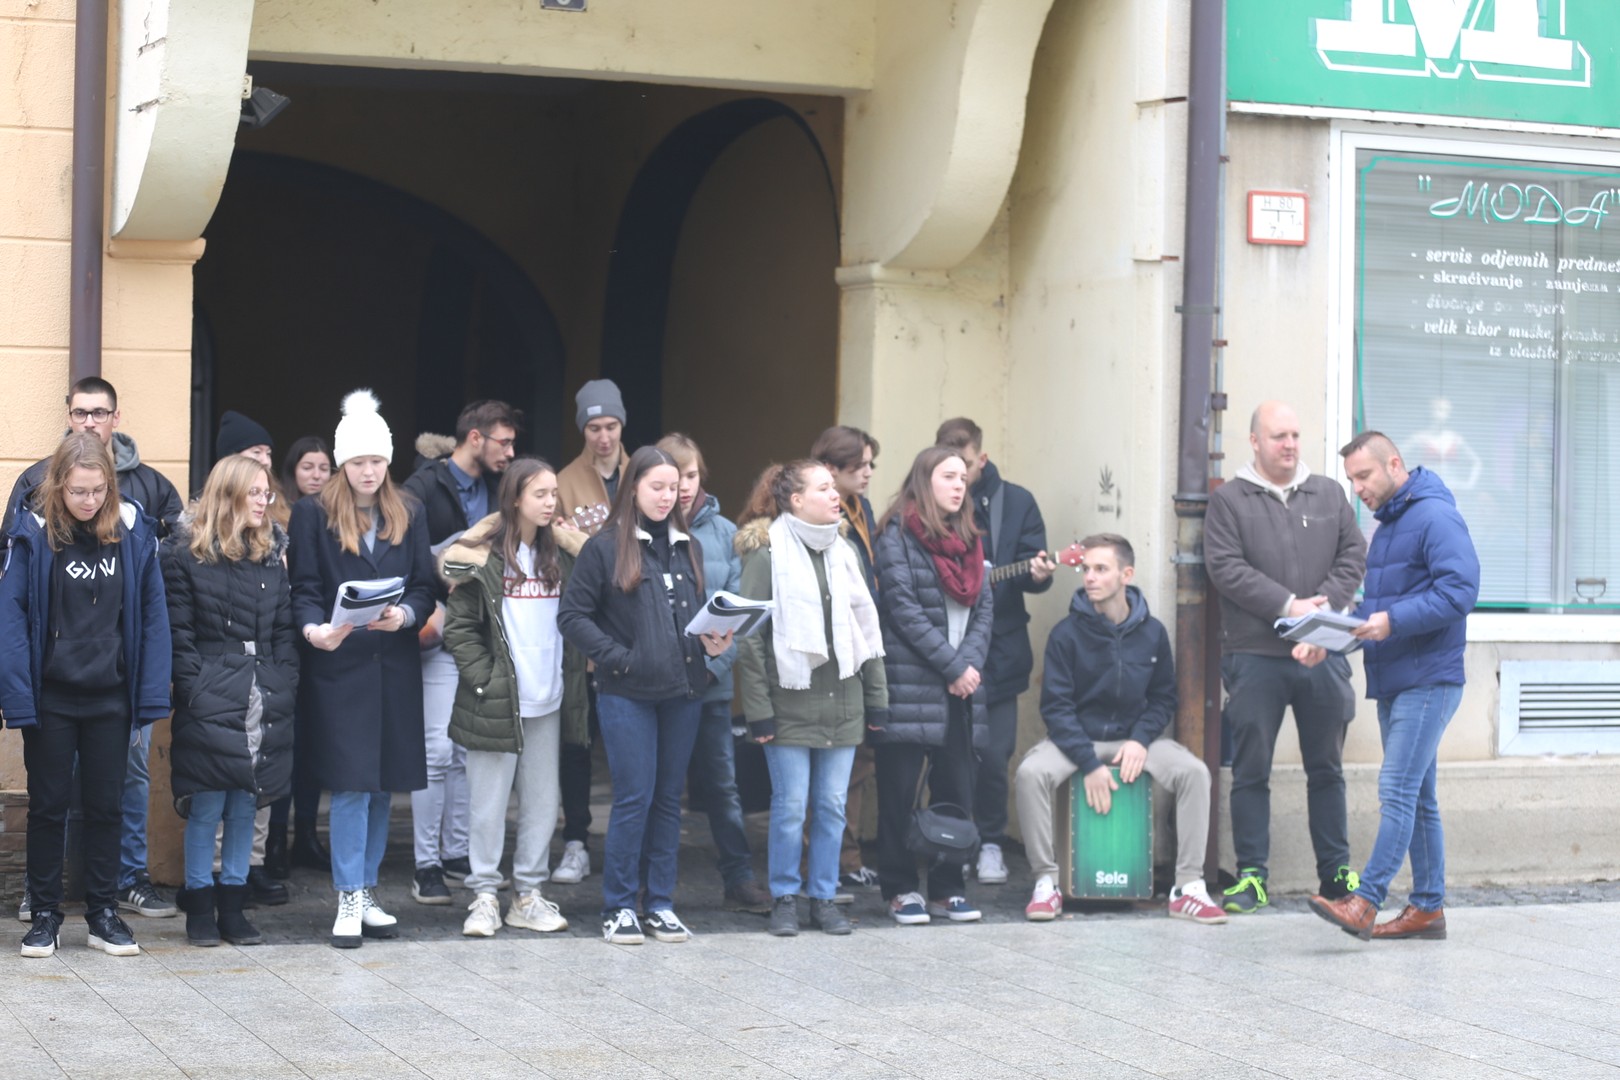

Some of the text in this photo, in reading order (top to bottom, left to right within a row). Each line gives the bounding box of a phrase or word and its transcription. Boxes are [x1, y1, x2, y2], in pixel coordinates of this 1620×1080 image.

[1426, 247, 1472, 264] servis
[1481, 249, 1549, 269] odjevnih
[1433, 270, 1523, 290] skraćivanje
[1424, 318, 1458, 335] velik
[1465, 319, 1501, 337] izbor
[1489, 341, 1503, 357] iz
[1095, 870, 1128, 885] Sela
